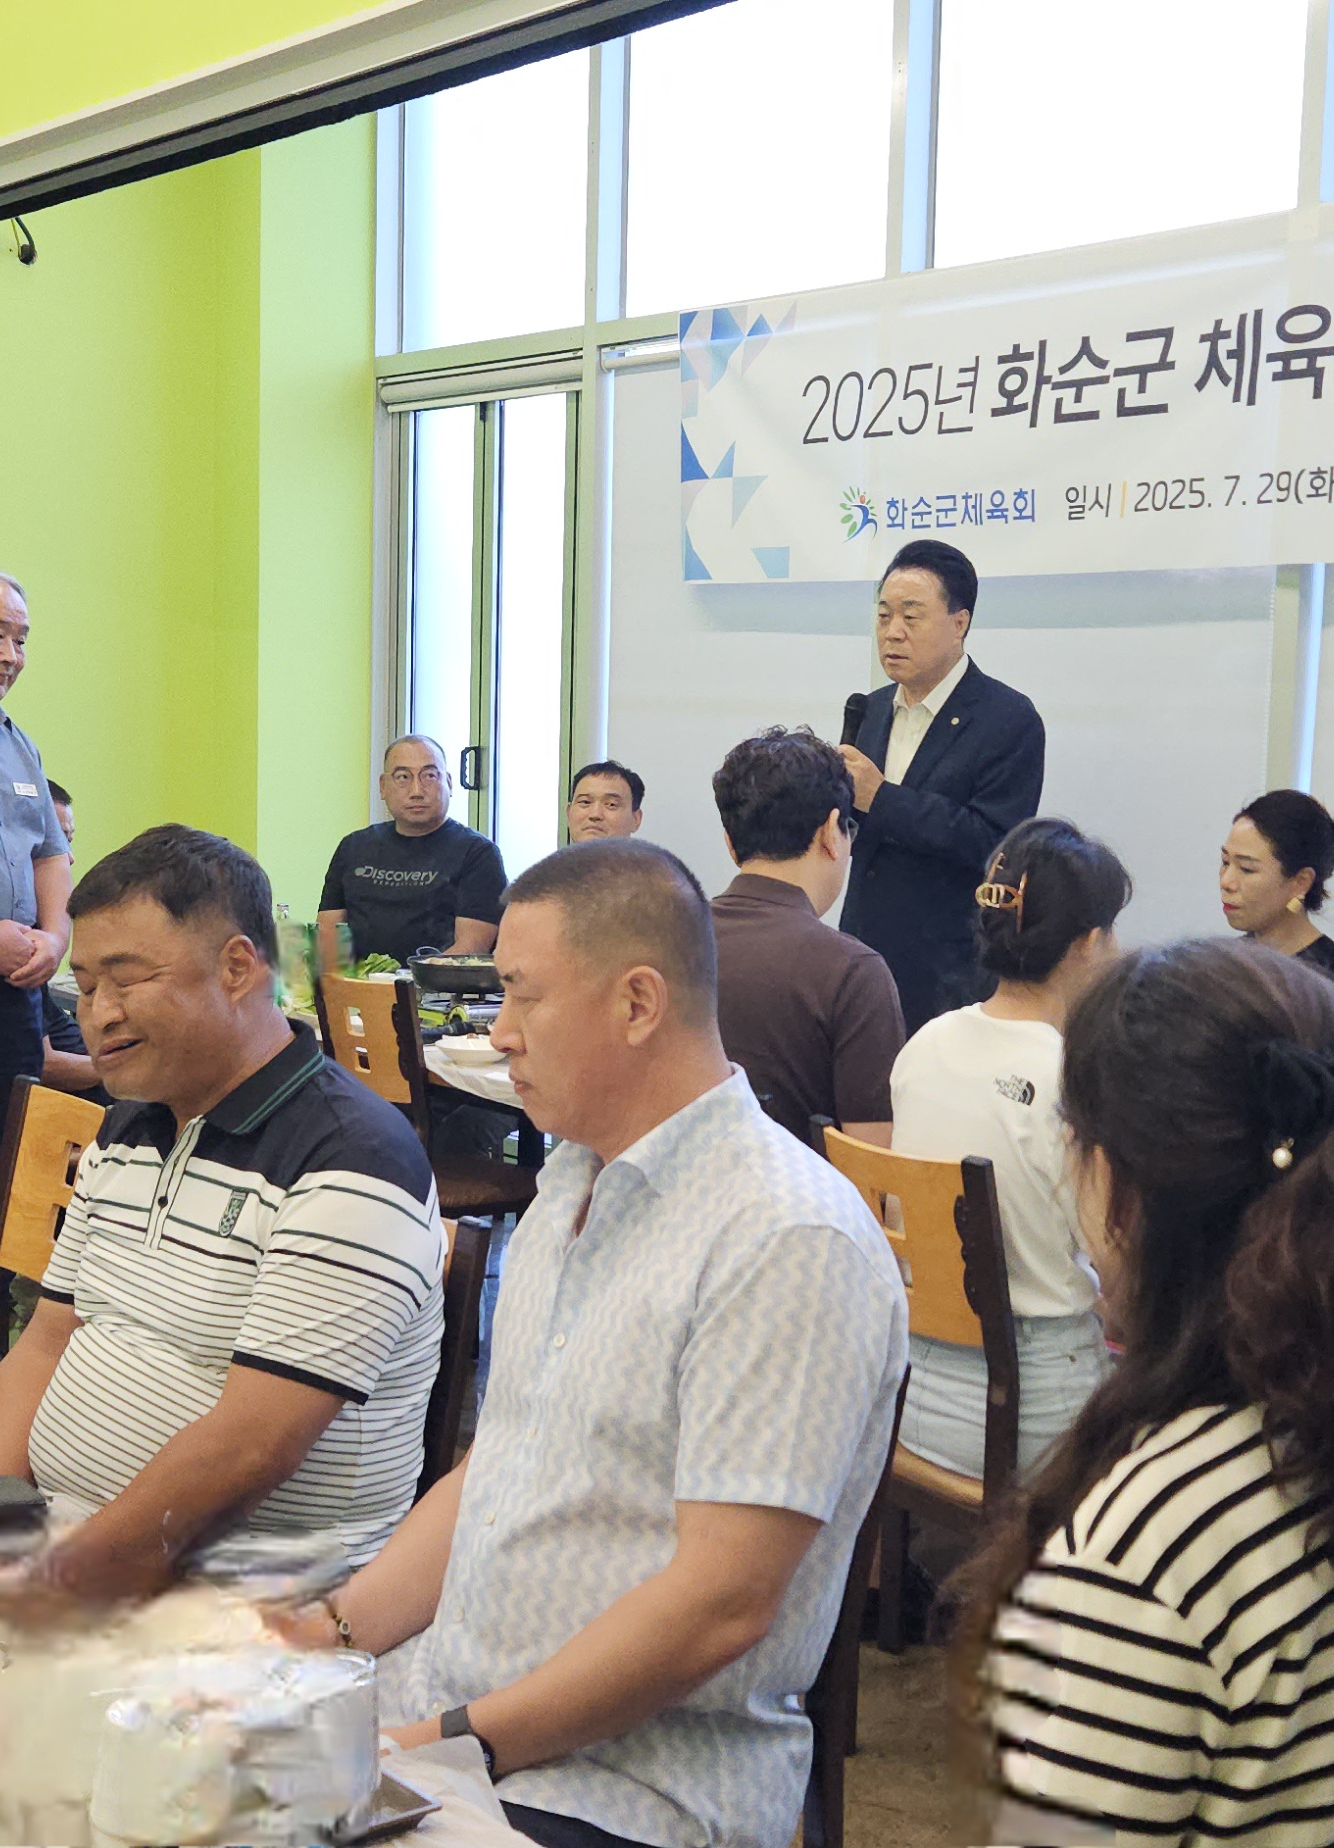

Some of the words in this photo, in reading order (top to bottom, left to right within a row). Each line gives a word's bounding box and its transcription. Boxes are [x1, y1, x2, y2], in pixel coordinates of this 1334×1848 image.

[801, 354, 980, 445] 2025년
[990, 326, 1177, 429] 화순군
[884, 487, 1037, 531] 화순군체육회
[1065, 483, 1111, 521] 일시
[1133, 477, 1213, 513] 2025.
[1223, 475, 1247, 507] 7.
